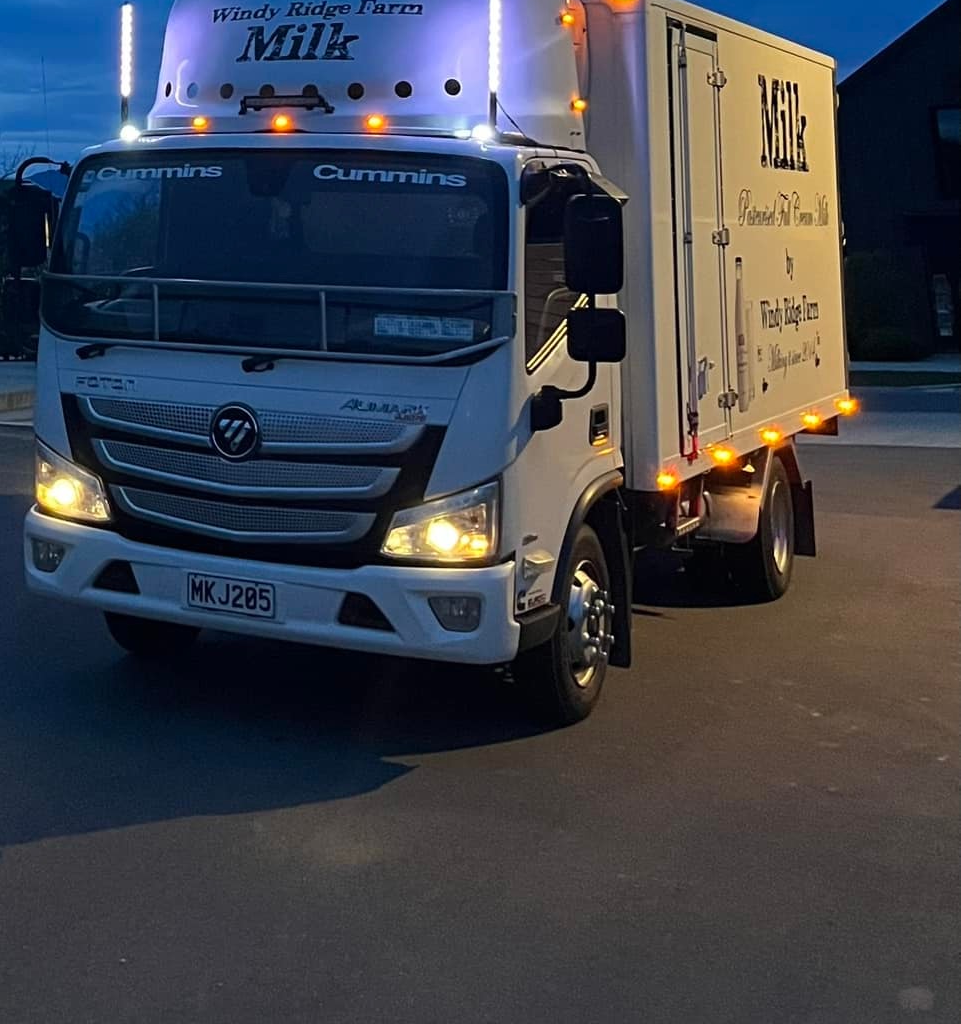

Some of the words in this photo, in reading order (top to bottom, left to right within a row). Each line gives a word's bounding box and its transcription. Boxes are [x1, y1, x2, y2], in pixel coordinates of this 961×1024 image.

[213, 4, 282, 23] Windy
[285, 0, 351, 19] Ridge
[355, 0, 423, 15] Farm
[236, 22, 359, 62] Milk
[758, 74, 810, 172] Milk
[96, 163, 223, 180] Cummins
[313, 164, 467, 187] Cummins
[760, 298, 783, 333] Windy
[783, 296, 802, 332] Ridge
[802, 294, 819, 322] Farm
[191, 577, 271, 612] MKJ205
